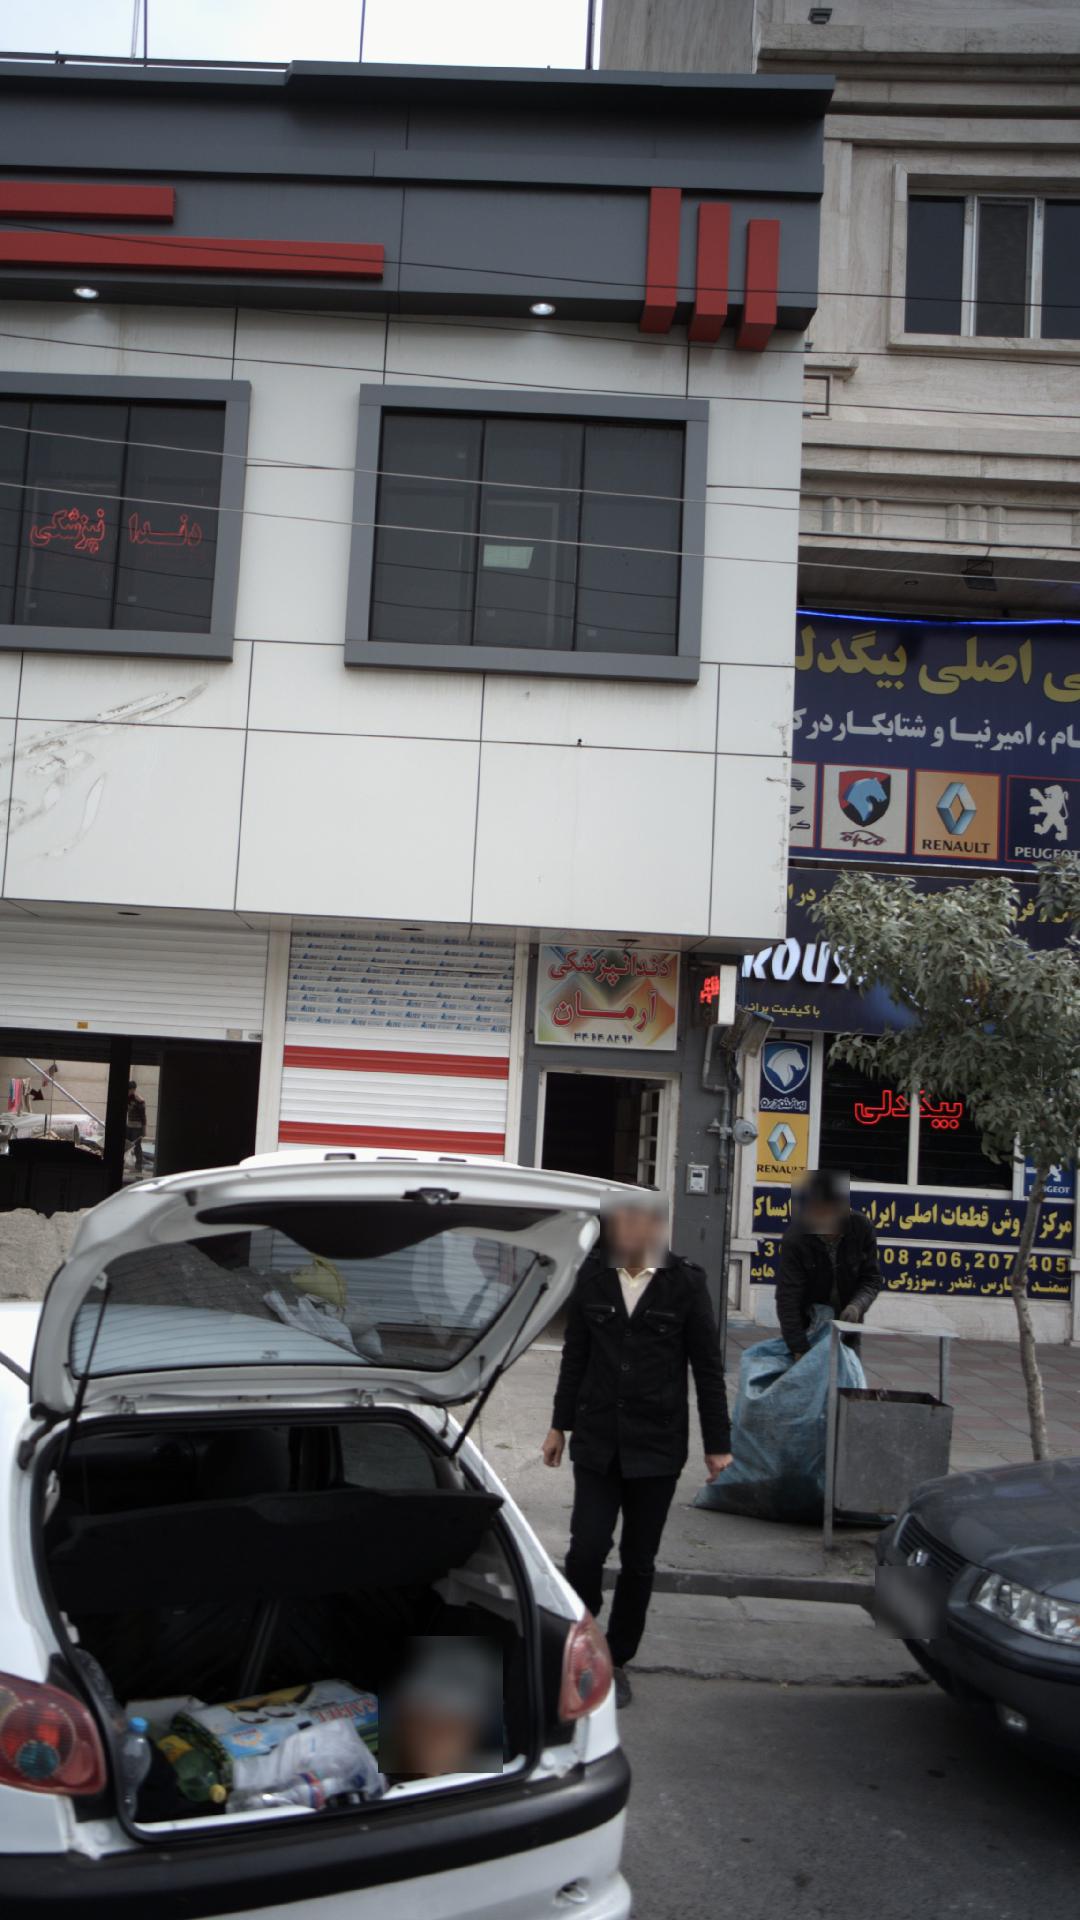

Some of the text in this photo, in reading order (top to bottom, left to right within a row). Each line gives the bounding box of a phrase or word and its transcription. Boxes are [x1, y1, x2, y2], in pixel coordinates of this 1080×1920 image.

[794, 624, 908, 691] بیگدل
[918, 635, 1033, 695] اصلی
[793, 707, 808, 731] ک
[805, 712, 833, 740] در
[929, 728, 945, 748] و
[921, 838, 991, 855] RENAULT
[1014, 846, 1080, 861] PEUGEOT
[548, 949, 672, 987] دندانپزشکی
[741, 937, 856, 985] KOUS
[551, 988, 657, 1032] آرمان
[898, 1201, 938, 1230] اصلی
[940, 1205, 989, 1229] قطعات
[991, 1208, 1021, 1237] وش
[1038, 1211, 1072, 1240] مرکز
